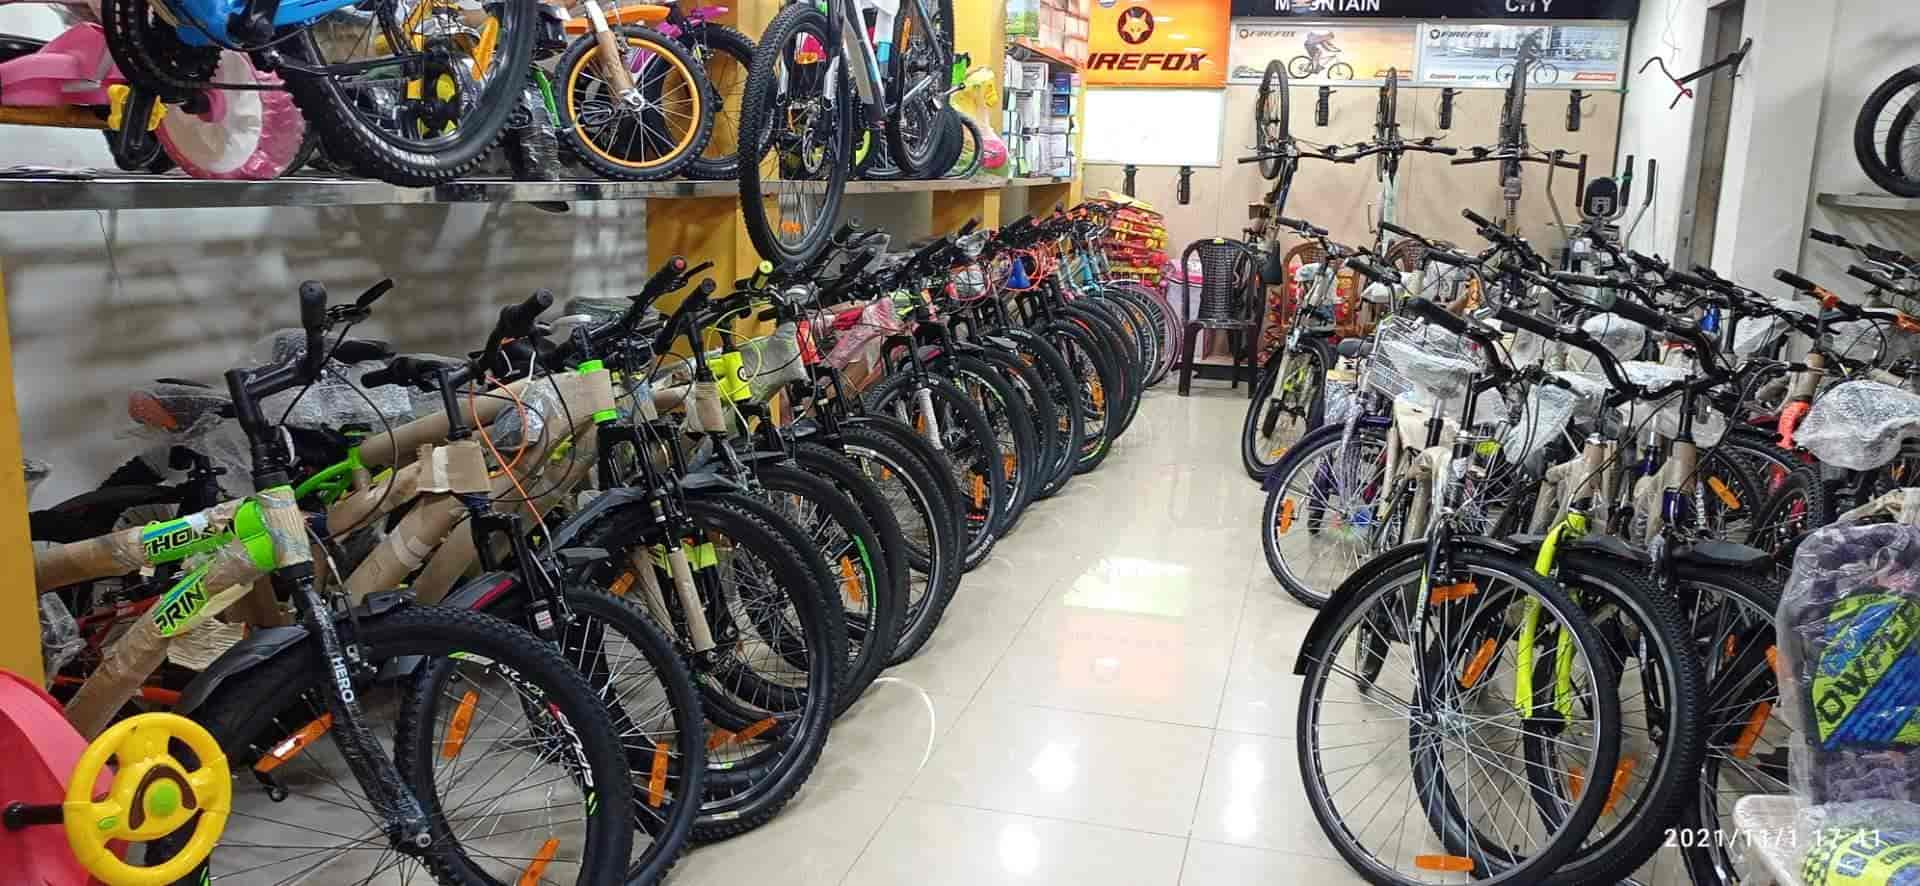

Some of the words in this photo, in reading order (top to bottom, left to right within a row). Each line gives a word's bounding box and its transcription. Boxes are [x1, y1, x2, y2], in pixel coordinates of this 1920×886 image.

[1275, 0, 1380, 11] MUNTAIN
[1087, 53, 1207, 71] IREFOX
[155, 579, 206, 631] PRIN
[331, 656, 355, 703] HERO
